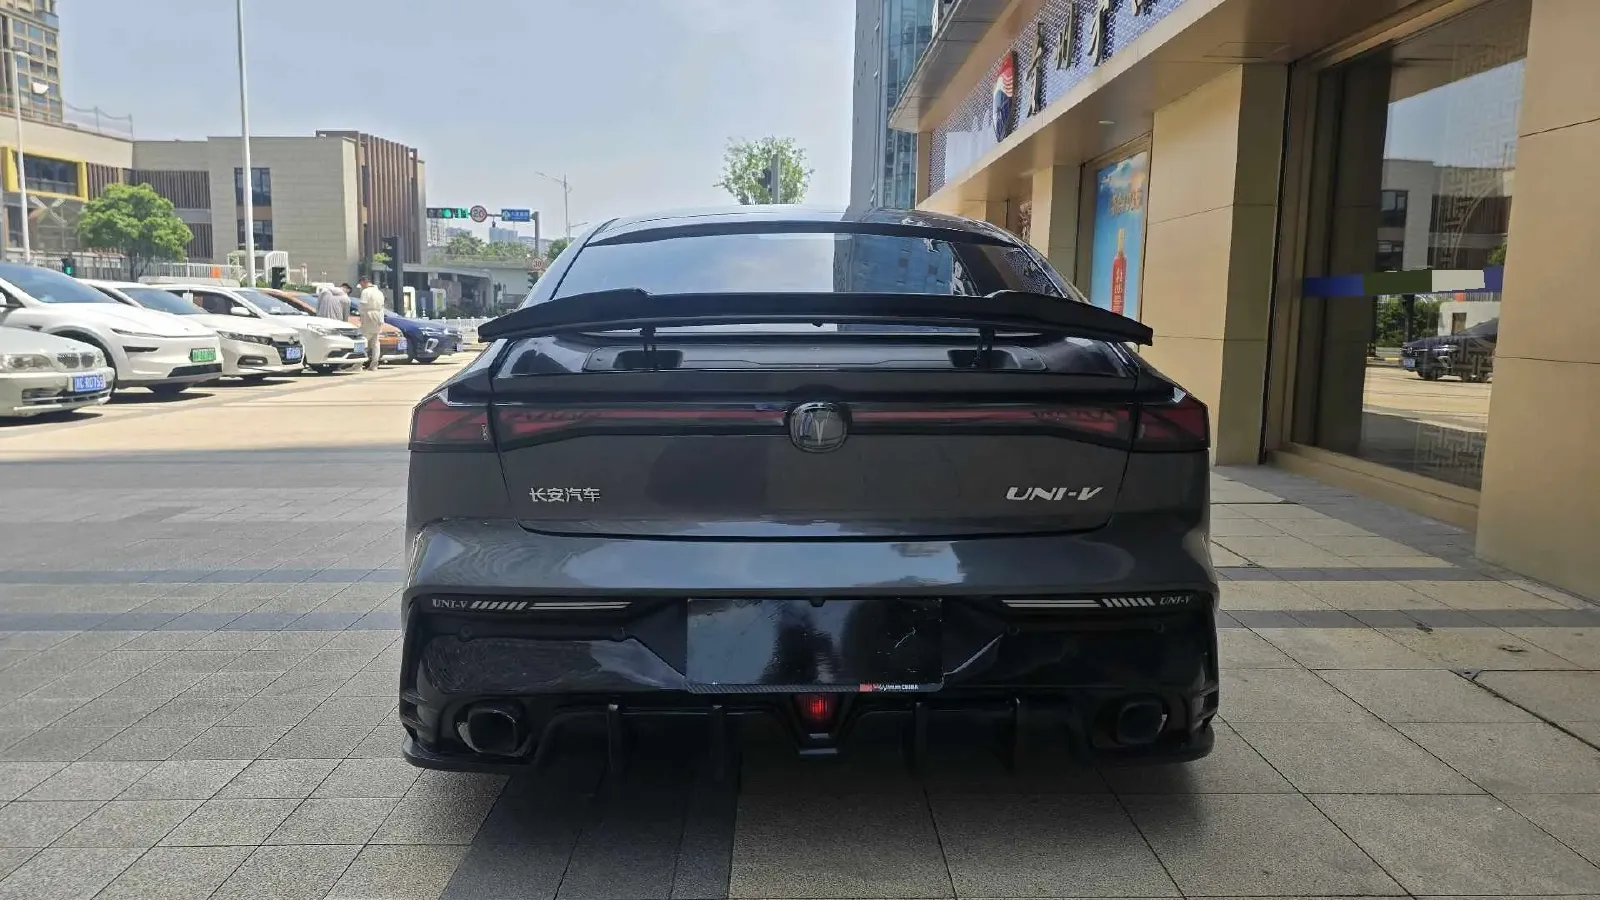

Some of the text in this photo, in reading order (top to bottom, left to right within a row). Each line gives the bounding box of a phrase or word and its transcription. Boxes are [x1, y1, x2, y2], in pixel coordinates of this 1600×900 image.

[529, 487, 600, 502] 长安汽车
[1006, 487, 1104, 501] UNI-V
[432, 598, 467, 608] UNI-V
[1160, 596, 1193, 606] UNI-V
